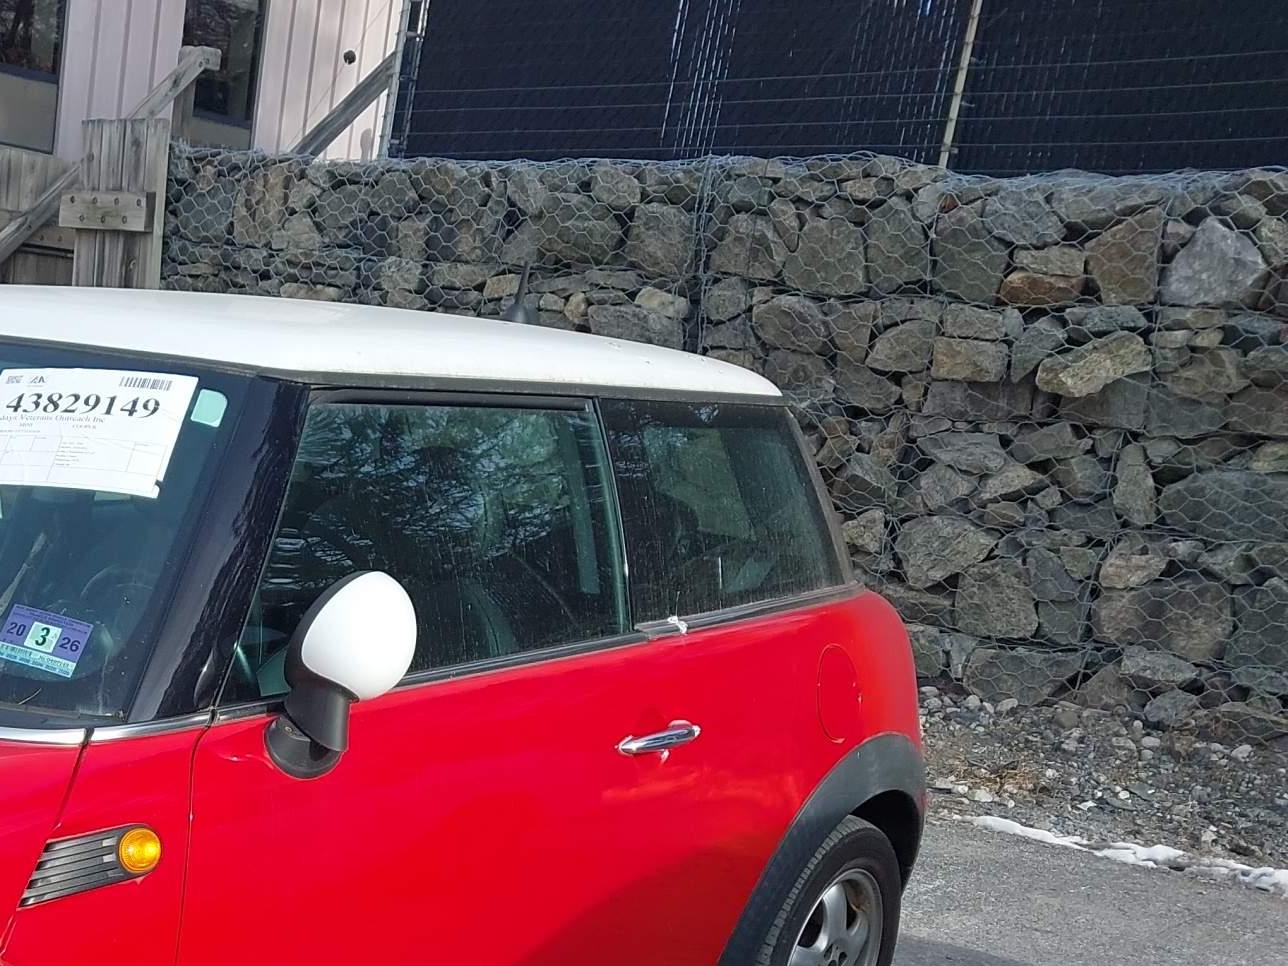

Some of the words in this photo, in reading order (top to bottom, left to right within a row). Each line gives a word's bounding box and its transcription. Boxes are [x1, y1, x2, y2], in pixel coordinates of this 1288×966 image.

[6, 392, 161, 419] 43829149
[55, 414, 91, 423] Outreach
[6, 622, 27, 637] 20
[34, 627, 51, 646] 3
[58, 637, 81, 652] 26
